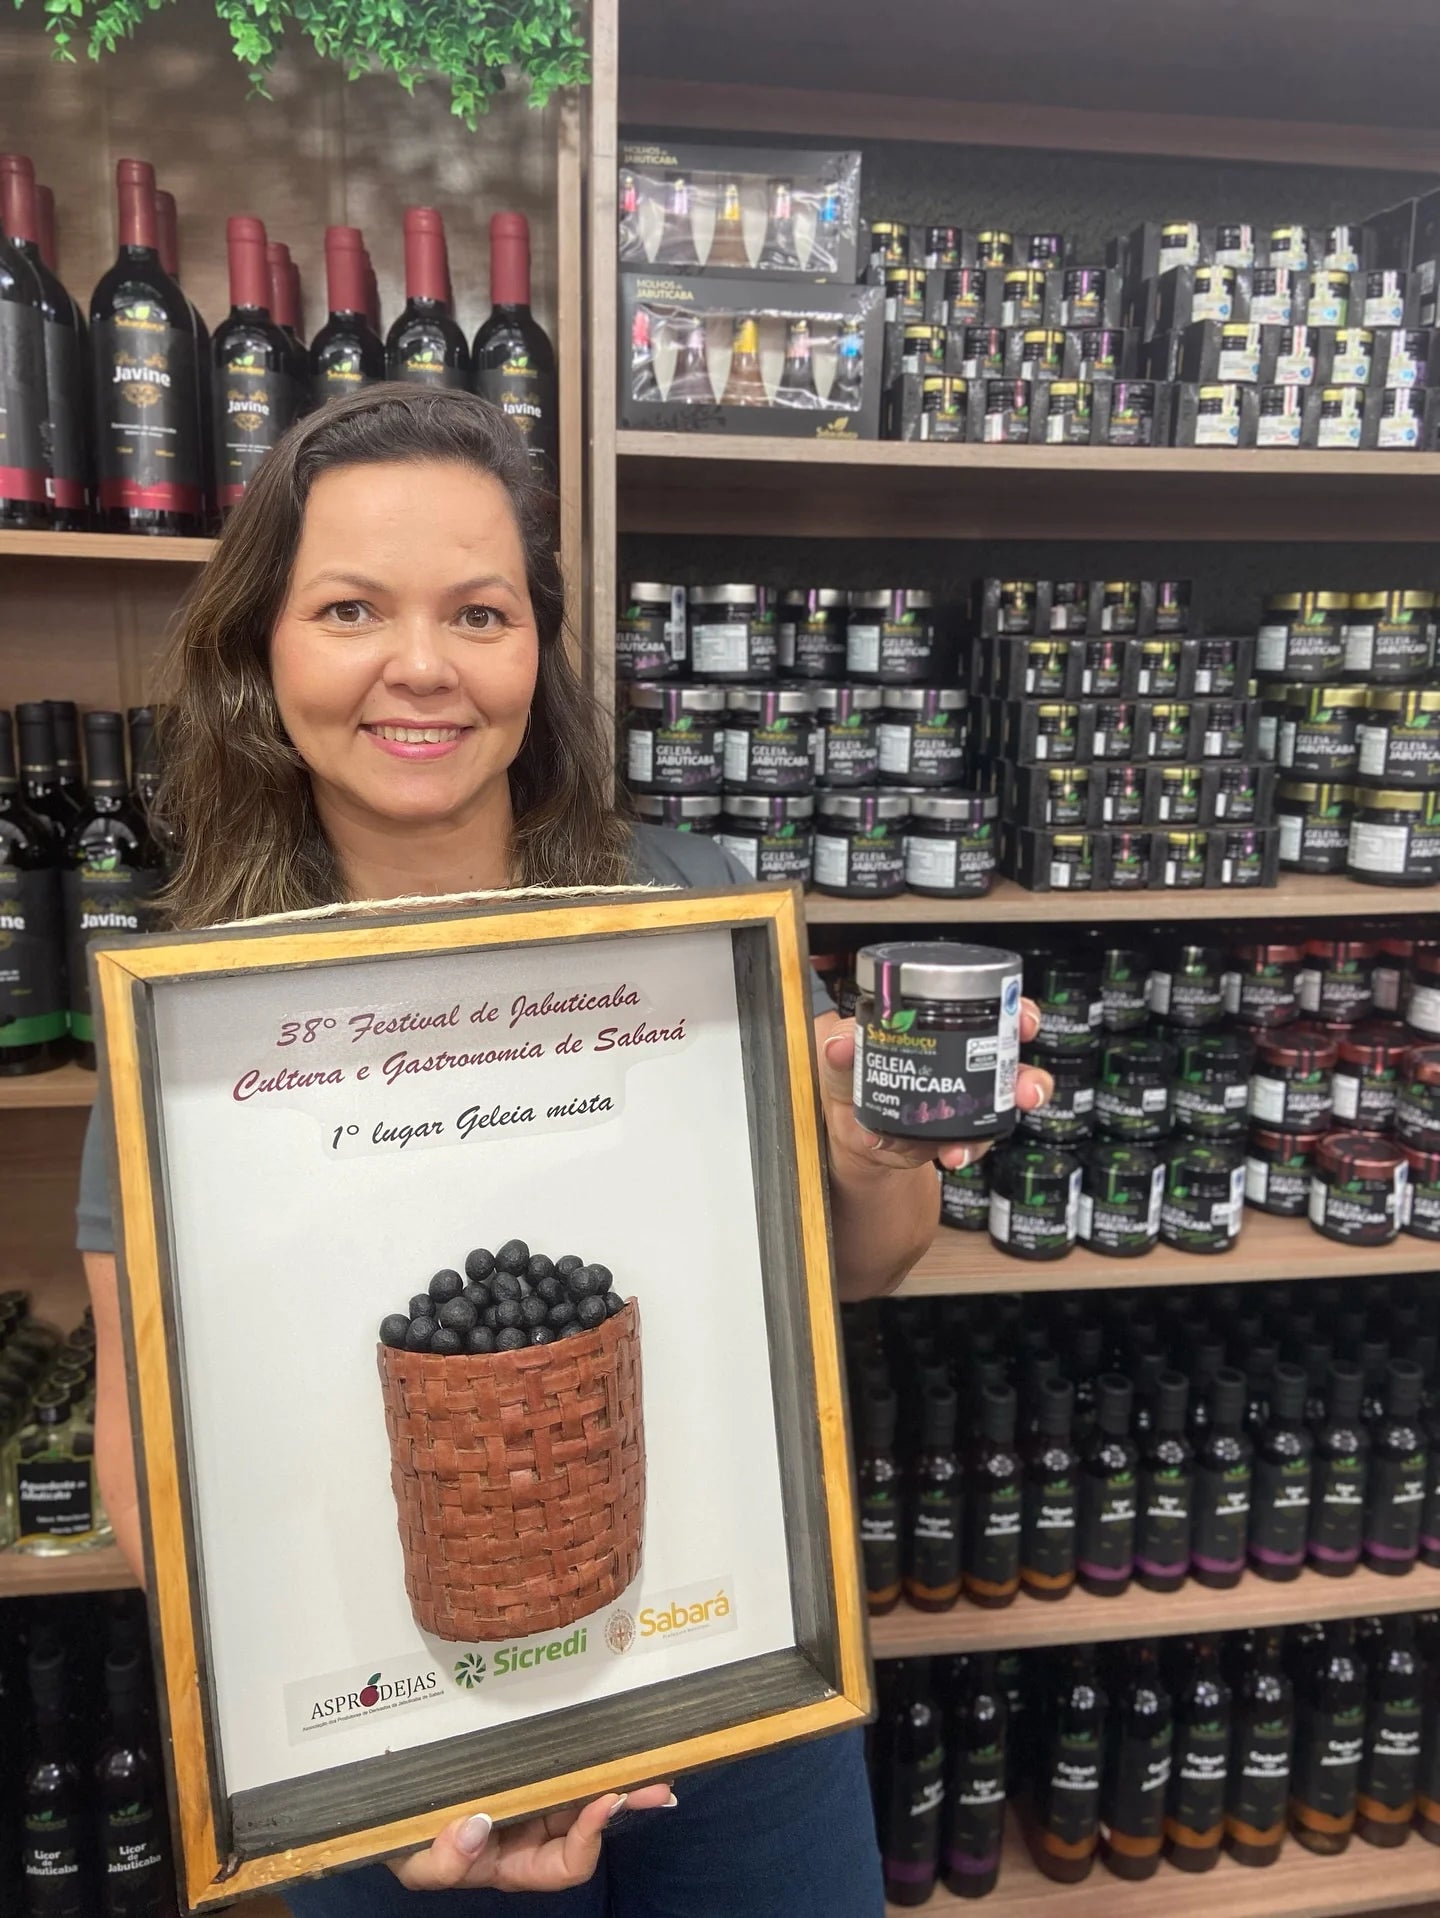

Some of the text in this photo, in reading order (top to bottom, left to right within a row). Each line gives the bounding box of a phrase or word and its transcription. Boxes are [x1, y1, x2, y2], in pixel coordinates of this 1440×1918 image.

[636, 279, 676, 290] MOLHOS
[636, 288, 694, 301] JABUTICABA
[113, 365, 171, 387] Javine
[227, 400, 270, 416] Javine
[656, 745, 692, 755] GELEIA
[752, 745, 787, 756] GELEIA
[1389, 741, 1427, 751] GELEIA
[656, 755, 715, 766] JABUTICABA
[752, 755, 809, 766] JABUTICABA
[1389, 750, 1440, 761] JABUTICA
[80, 912, 138, 930] Javine
[348, 1004, 460, 1043] Festival
[470, 1001, 499, 1024] de
[509, 983, 641, 1029] Jabuticaba
[232, 1018, 686, 1102] Cultura e Gastronomia de Sabará
[866, 1052, 916, 1075] GELEIA
[866, 1069, 966, 1093] JABUTICABA
[872, 1091, 900, 1106] com
[371, 1121, 445, 1149] lugar
[456, 1105, 537, 1140] Geleia
[546, 1094, 615, 1119] mista
[639, 1589, 730, 1637] Sabará
[493, 1627, 588, 1677] Sicredi
[34, 1850, 61, 1860] Licor
[119, 1842, 147, 1856] Licor
[26, 1864, 79, 1876] Jabuticaba
[107, 1854, 162, 1874] Jabuticaba
